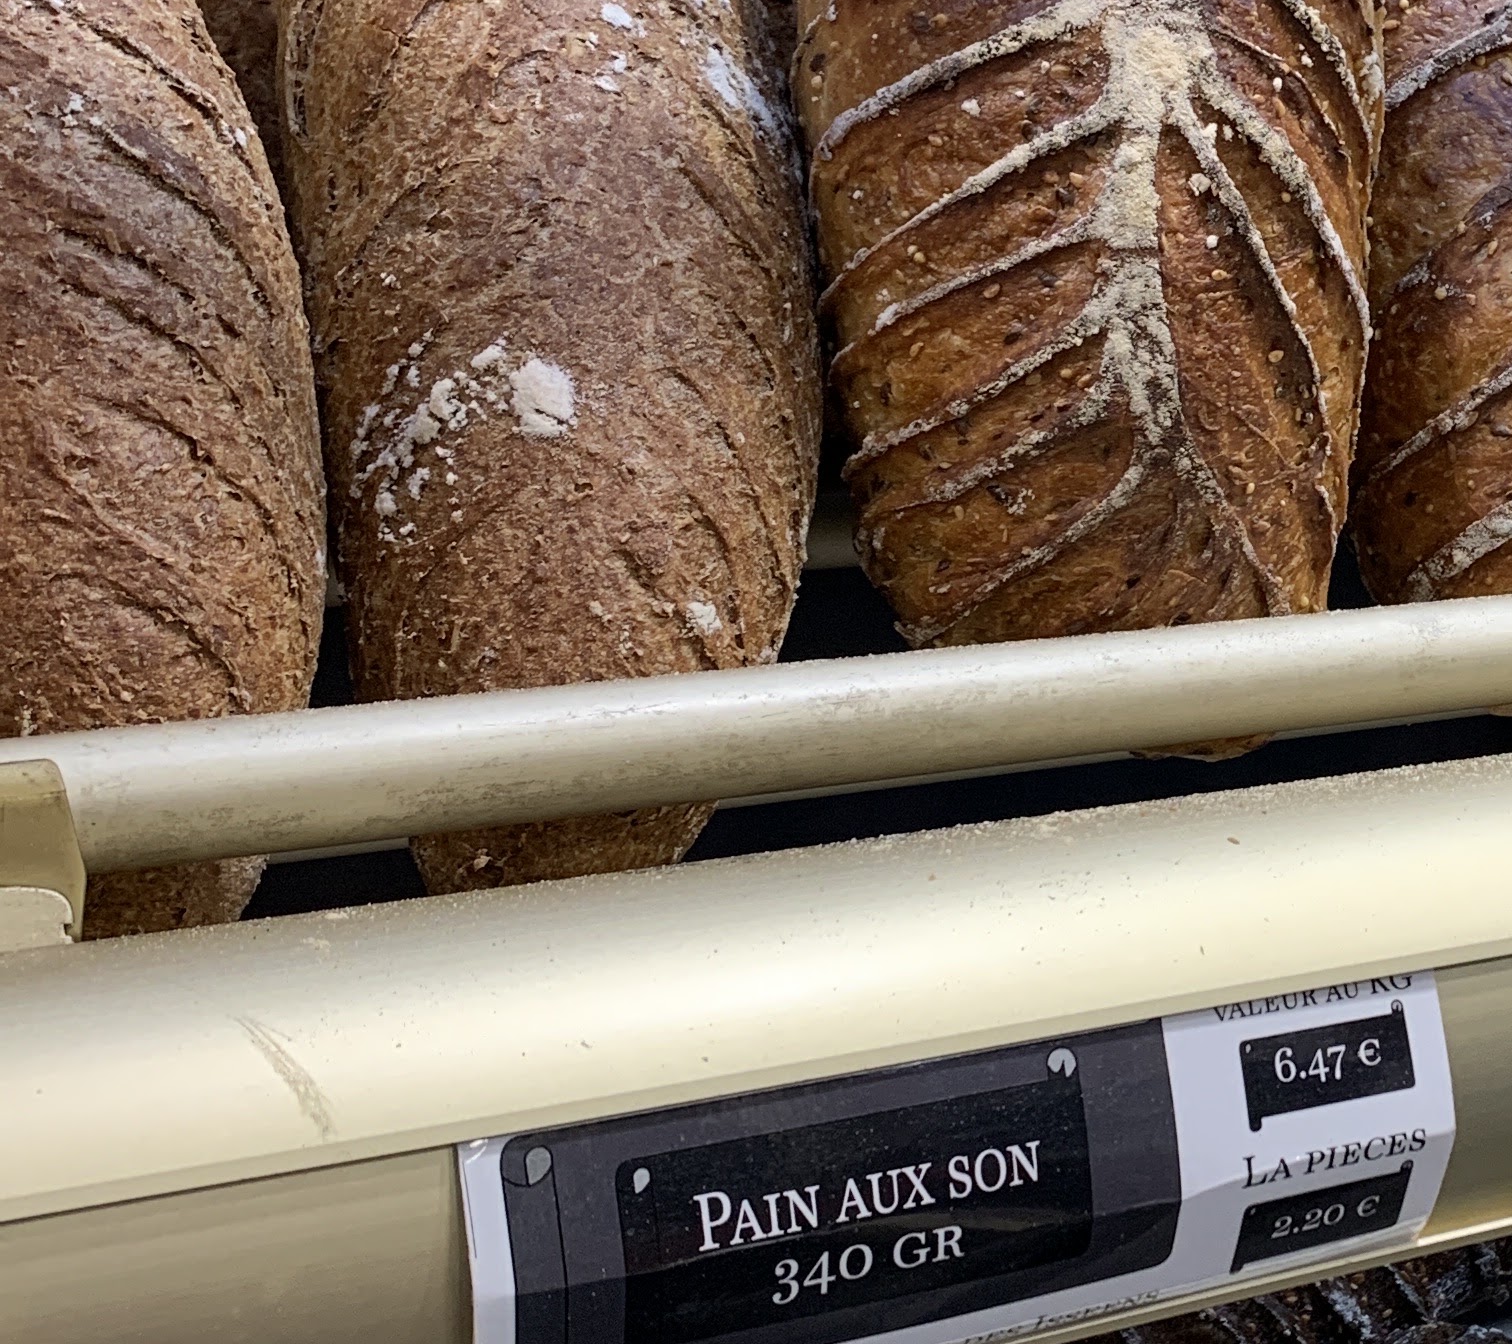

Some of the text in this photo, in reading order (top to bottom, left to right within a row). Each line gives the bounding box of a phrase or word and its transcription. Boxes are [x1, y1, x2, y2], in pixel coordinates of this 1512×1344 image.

[1213, 989, 1318, 1022] VALEUR
[1273, 1037, 1383, 1084] 6.47 €
[1241, 1128, 1427, 1190] LA PIECES
[692, 1140, 1041, 1252] PAIN AUX SON
[1270, 1194, 1381, 1240] 2.20 €
[771, 1225, 965, 1305] 340 GR
